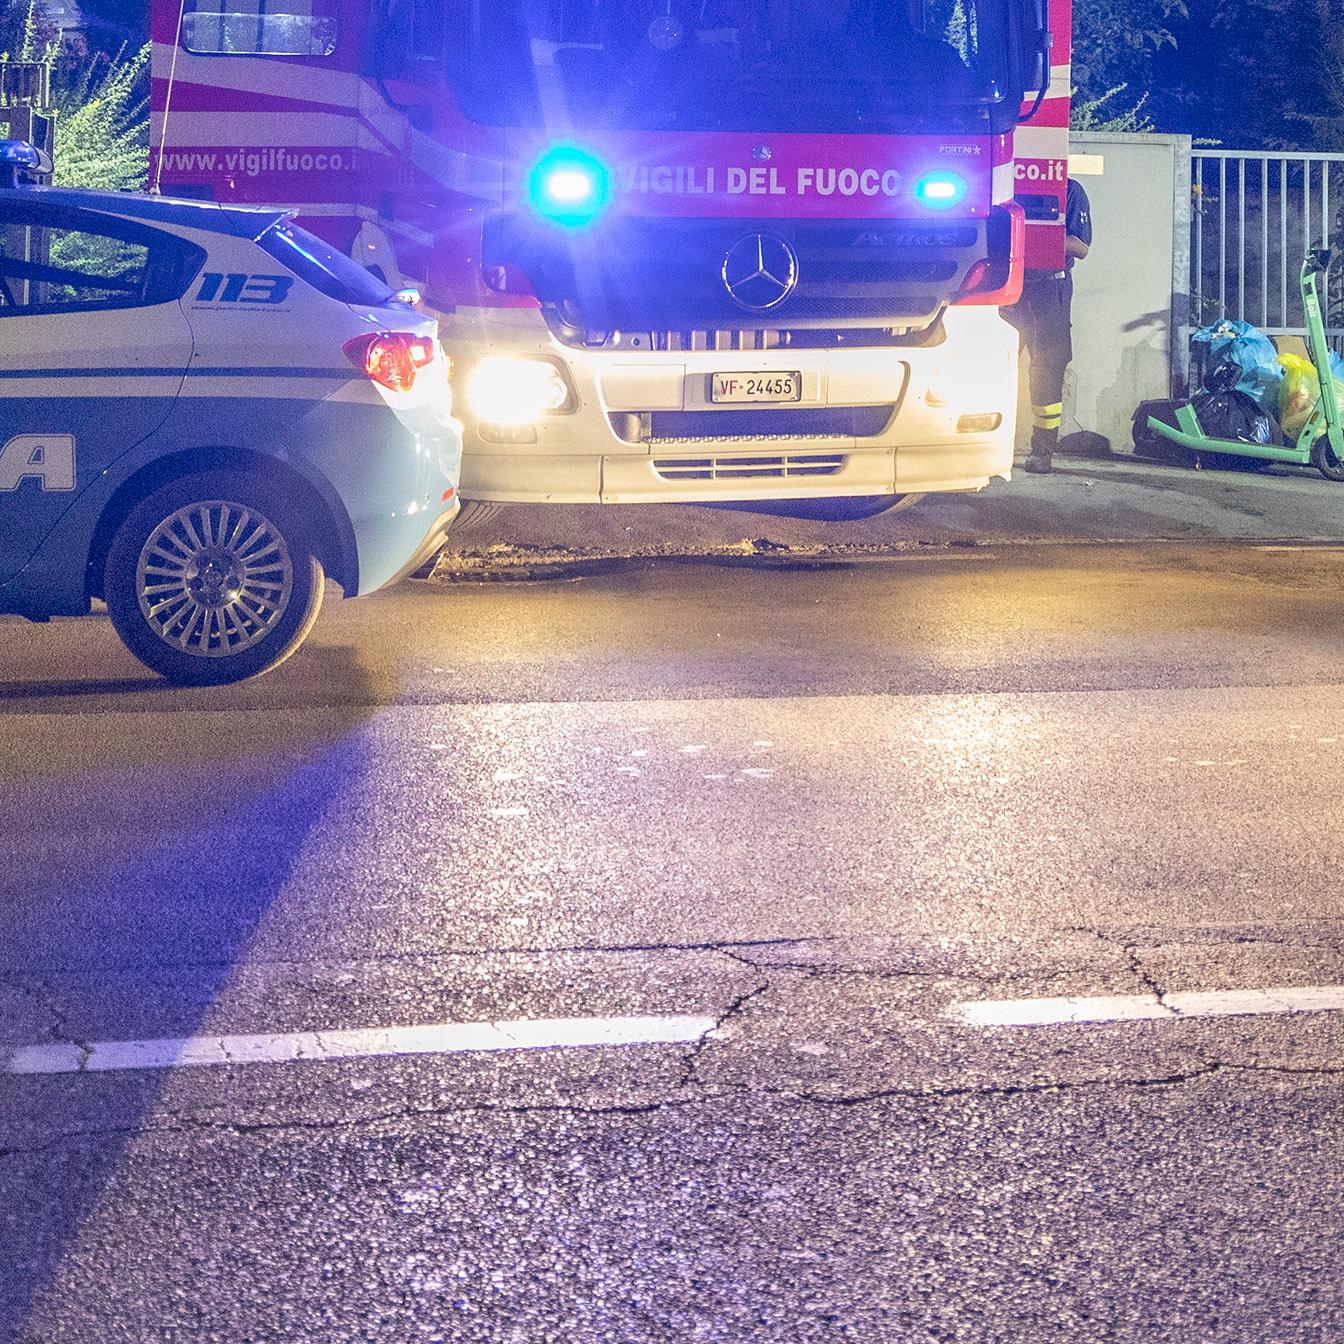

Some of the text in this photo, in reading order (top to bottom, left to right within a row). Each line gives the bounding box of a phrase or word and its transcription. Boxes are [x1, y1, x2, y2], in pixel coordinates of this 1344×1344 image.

[939, 143, 973, 153] FORTINI
[156, 148, 358, 177] www.vigilfuoco.i
[1014, 159, 1063, 181] co.it
[617, 166, 902, 196] VIGILI DEL FUOCO
[197, 272, 294, 304] 113
[1306, 298, 1317, 318] Bolt
[746, 379, 792, 395] 24455
